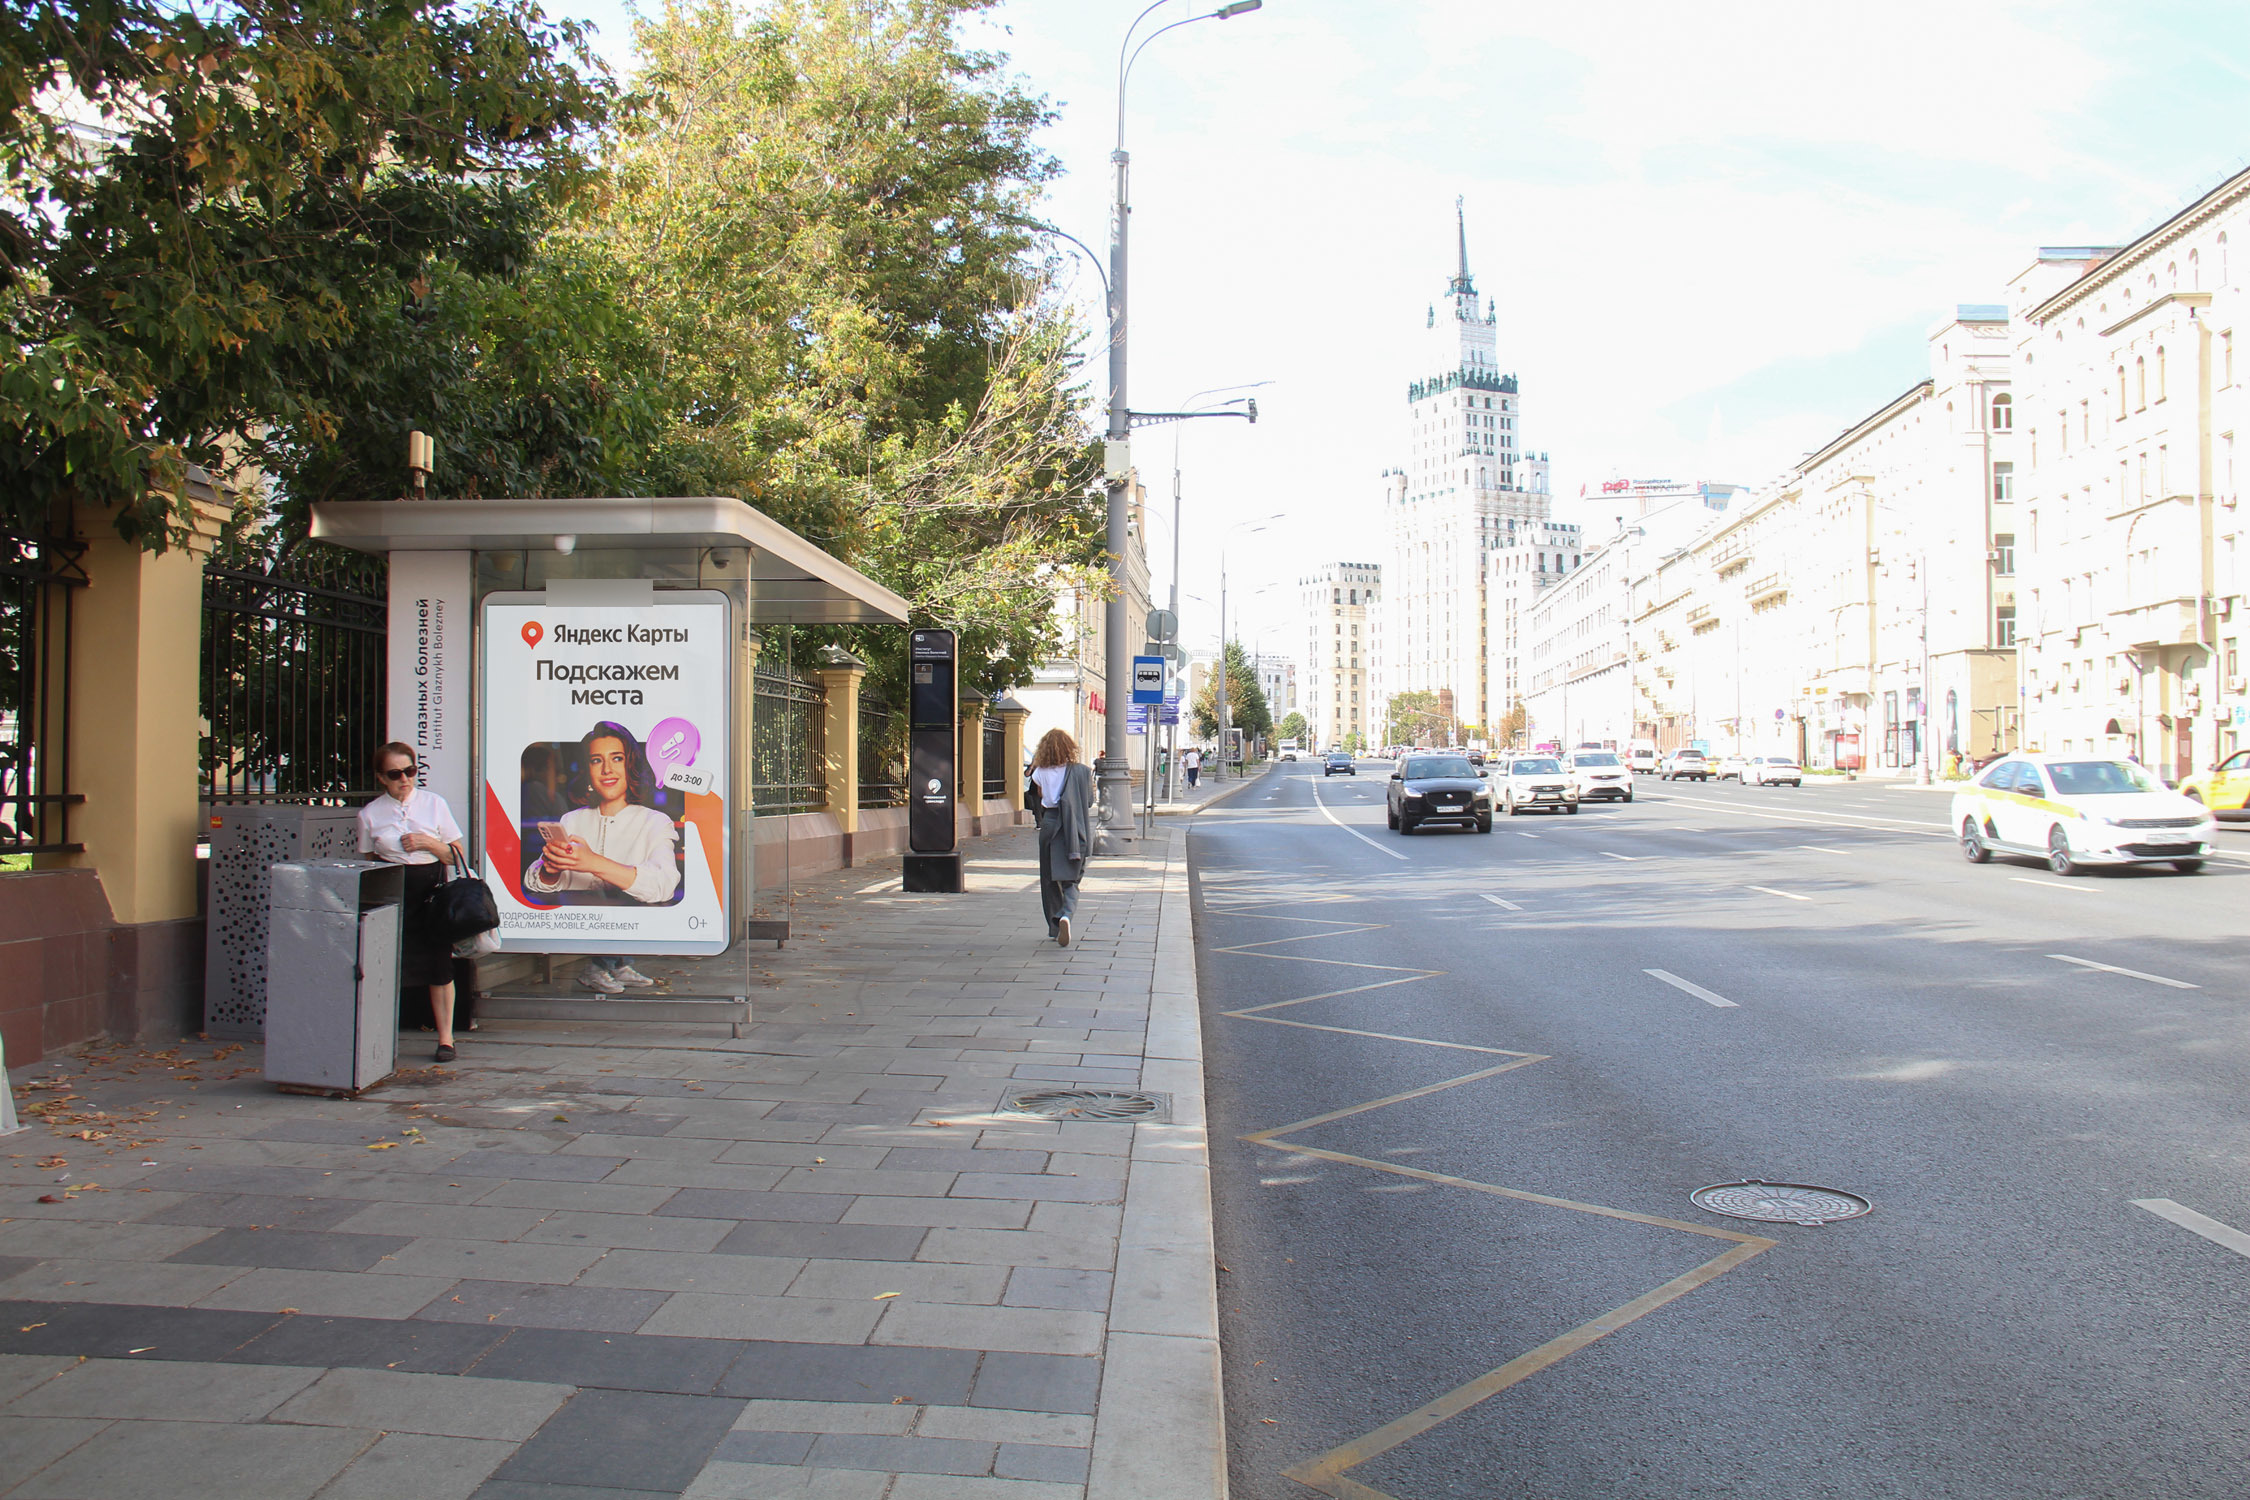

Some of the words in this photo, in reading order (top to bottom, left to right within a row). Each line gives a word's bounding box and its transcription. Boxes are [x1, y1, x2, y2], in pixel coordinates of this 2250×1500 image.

[415, 599, 429, 676] болезней
[433, 598, 445, 649] Bolezney
[554, 624, 622, 645] Яндекс
[627, 624, 688, 646] Карты
[433, 652, 445, 705] Glaznykh
[536, 660, 679, 684] Подскажем
[571, 689, 643, 705] места
[417, 680, 428, 746] глазных
[433, 708, 443, 750] Institut
[417, 753, 430, 789] итут
[670, 773, 683, 782] до
[683, 774, 702, 786] 3:00
[554, 912, 603, 921] YANDEX.RU/
[688, 915, 708, 930] 0+
